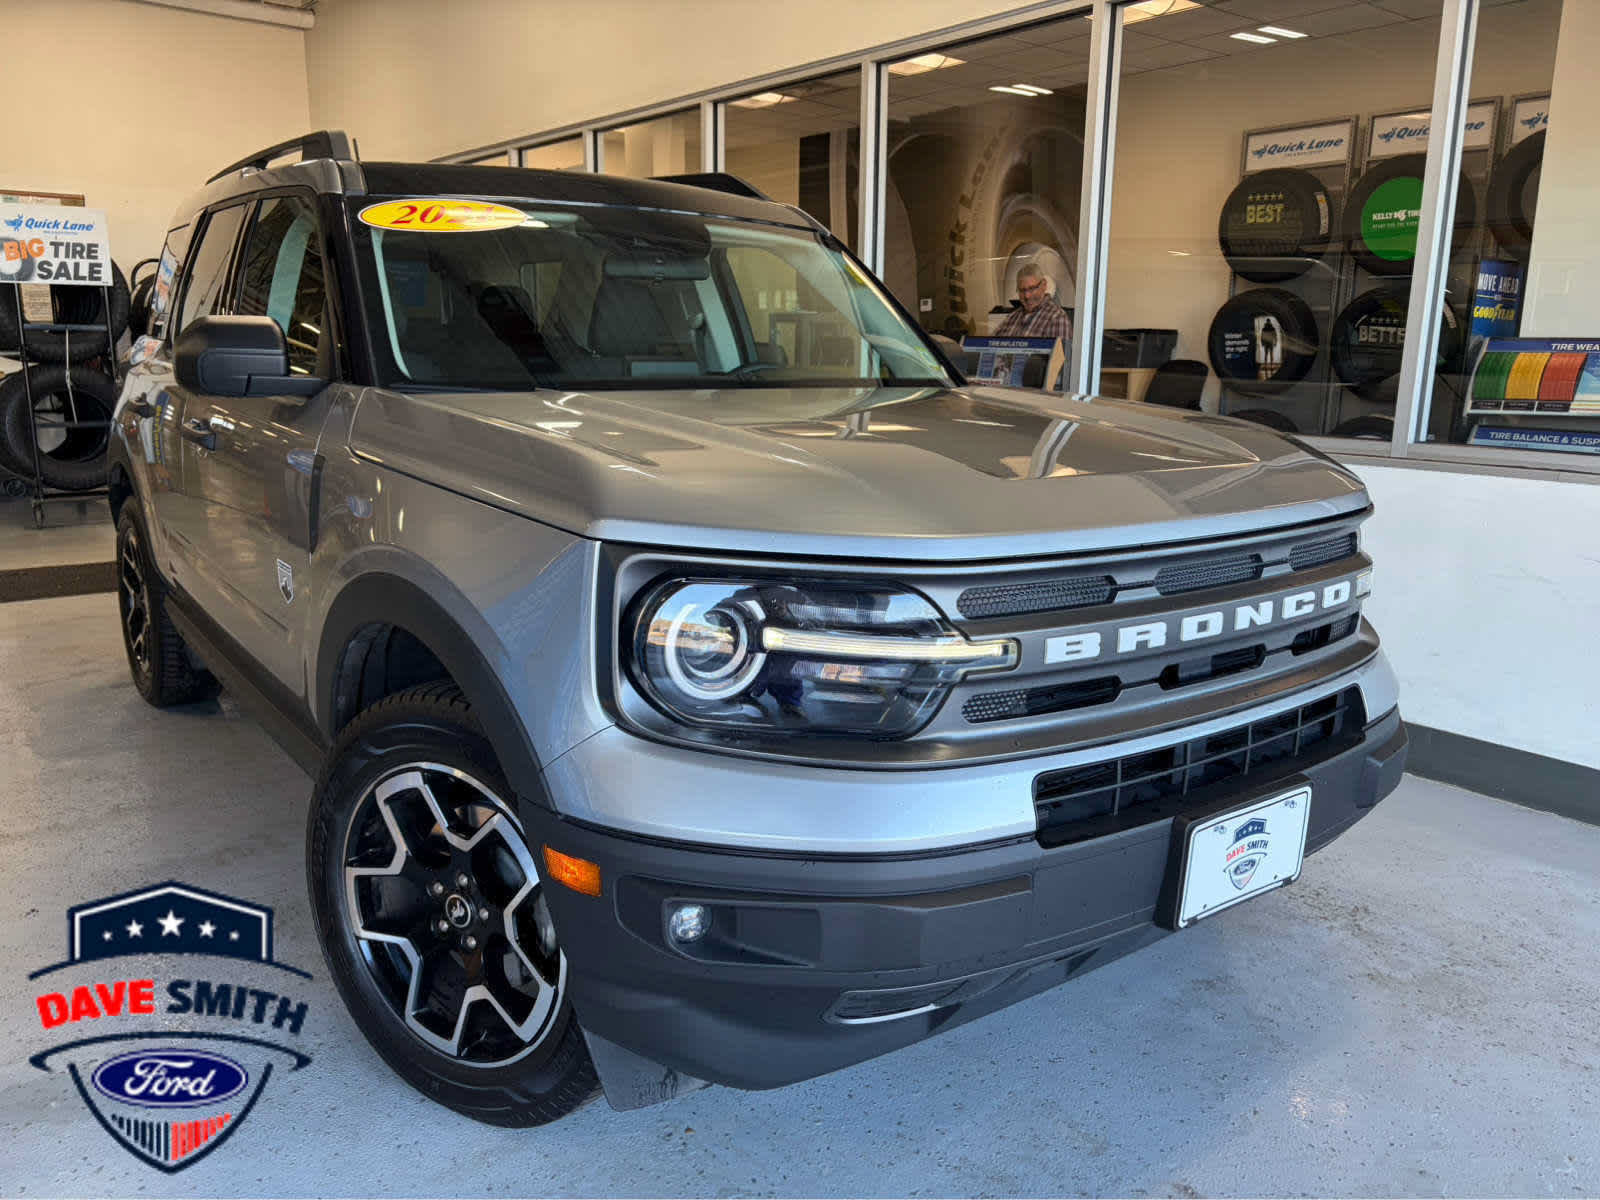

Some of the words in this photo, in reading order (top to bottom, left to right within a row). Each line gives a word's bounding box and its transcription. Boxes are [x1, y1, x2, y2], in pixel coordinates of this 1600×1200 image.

[1396, 124, 1430, 139] Quic
[1464, 121, 1485, 131] ne
[1267, 140, 1305, 155] Quick
[1306, 138, 1344, 150] Lane
[1246, 204, 1285, 224] BEST
[1372, 211, 1393, 220] KELLY
[25, 217, 60, 230] Quick
[63, 220, 94, 231] Lane
[3, 238, 45, 261] BIG
[49, 241, 99, 260] TIRE
[37, 260, 103, 281] SALE
[1477, 273, 1497, 291] MOVE
[1359, 325, 1406, 343] BETTE
[1552, 343, 1575, 351] TIRE
[1489, 431, 1511, 440] TIRE
[1512, 433, 1560, 443] BALANCE
[1560, 436, 1568, 444] &
[1044, 580, 1350, 664] BRONCO
[1226, 844, 1246, 862] DAVE
[1247, 840, 1268, 850] SMITH
